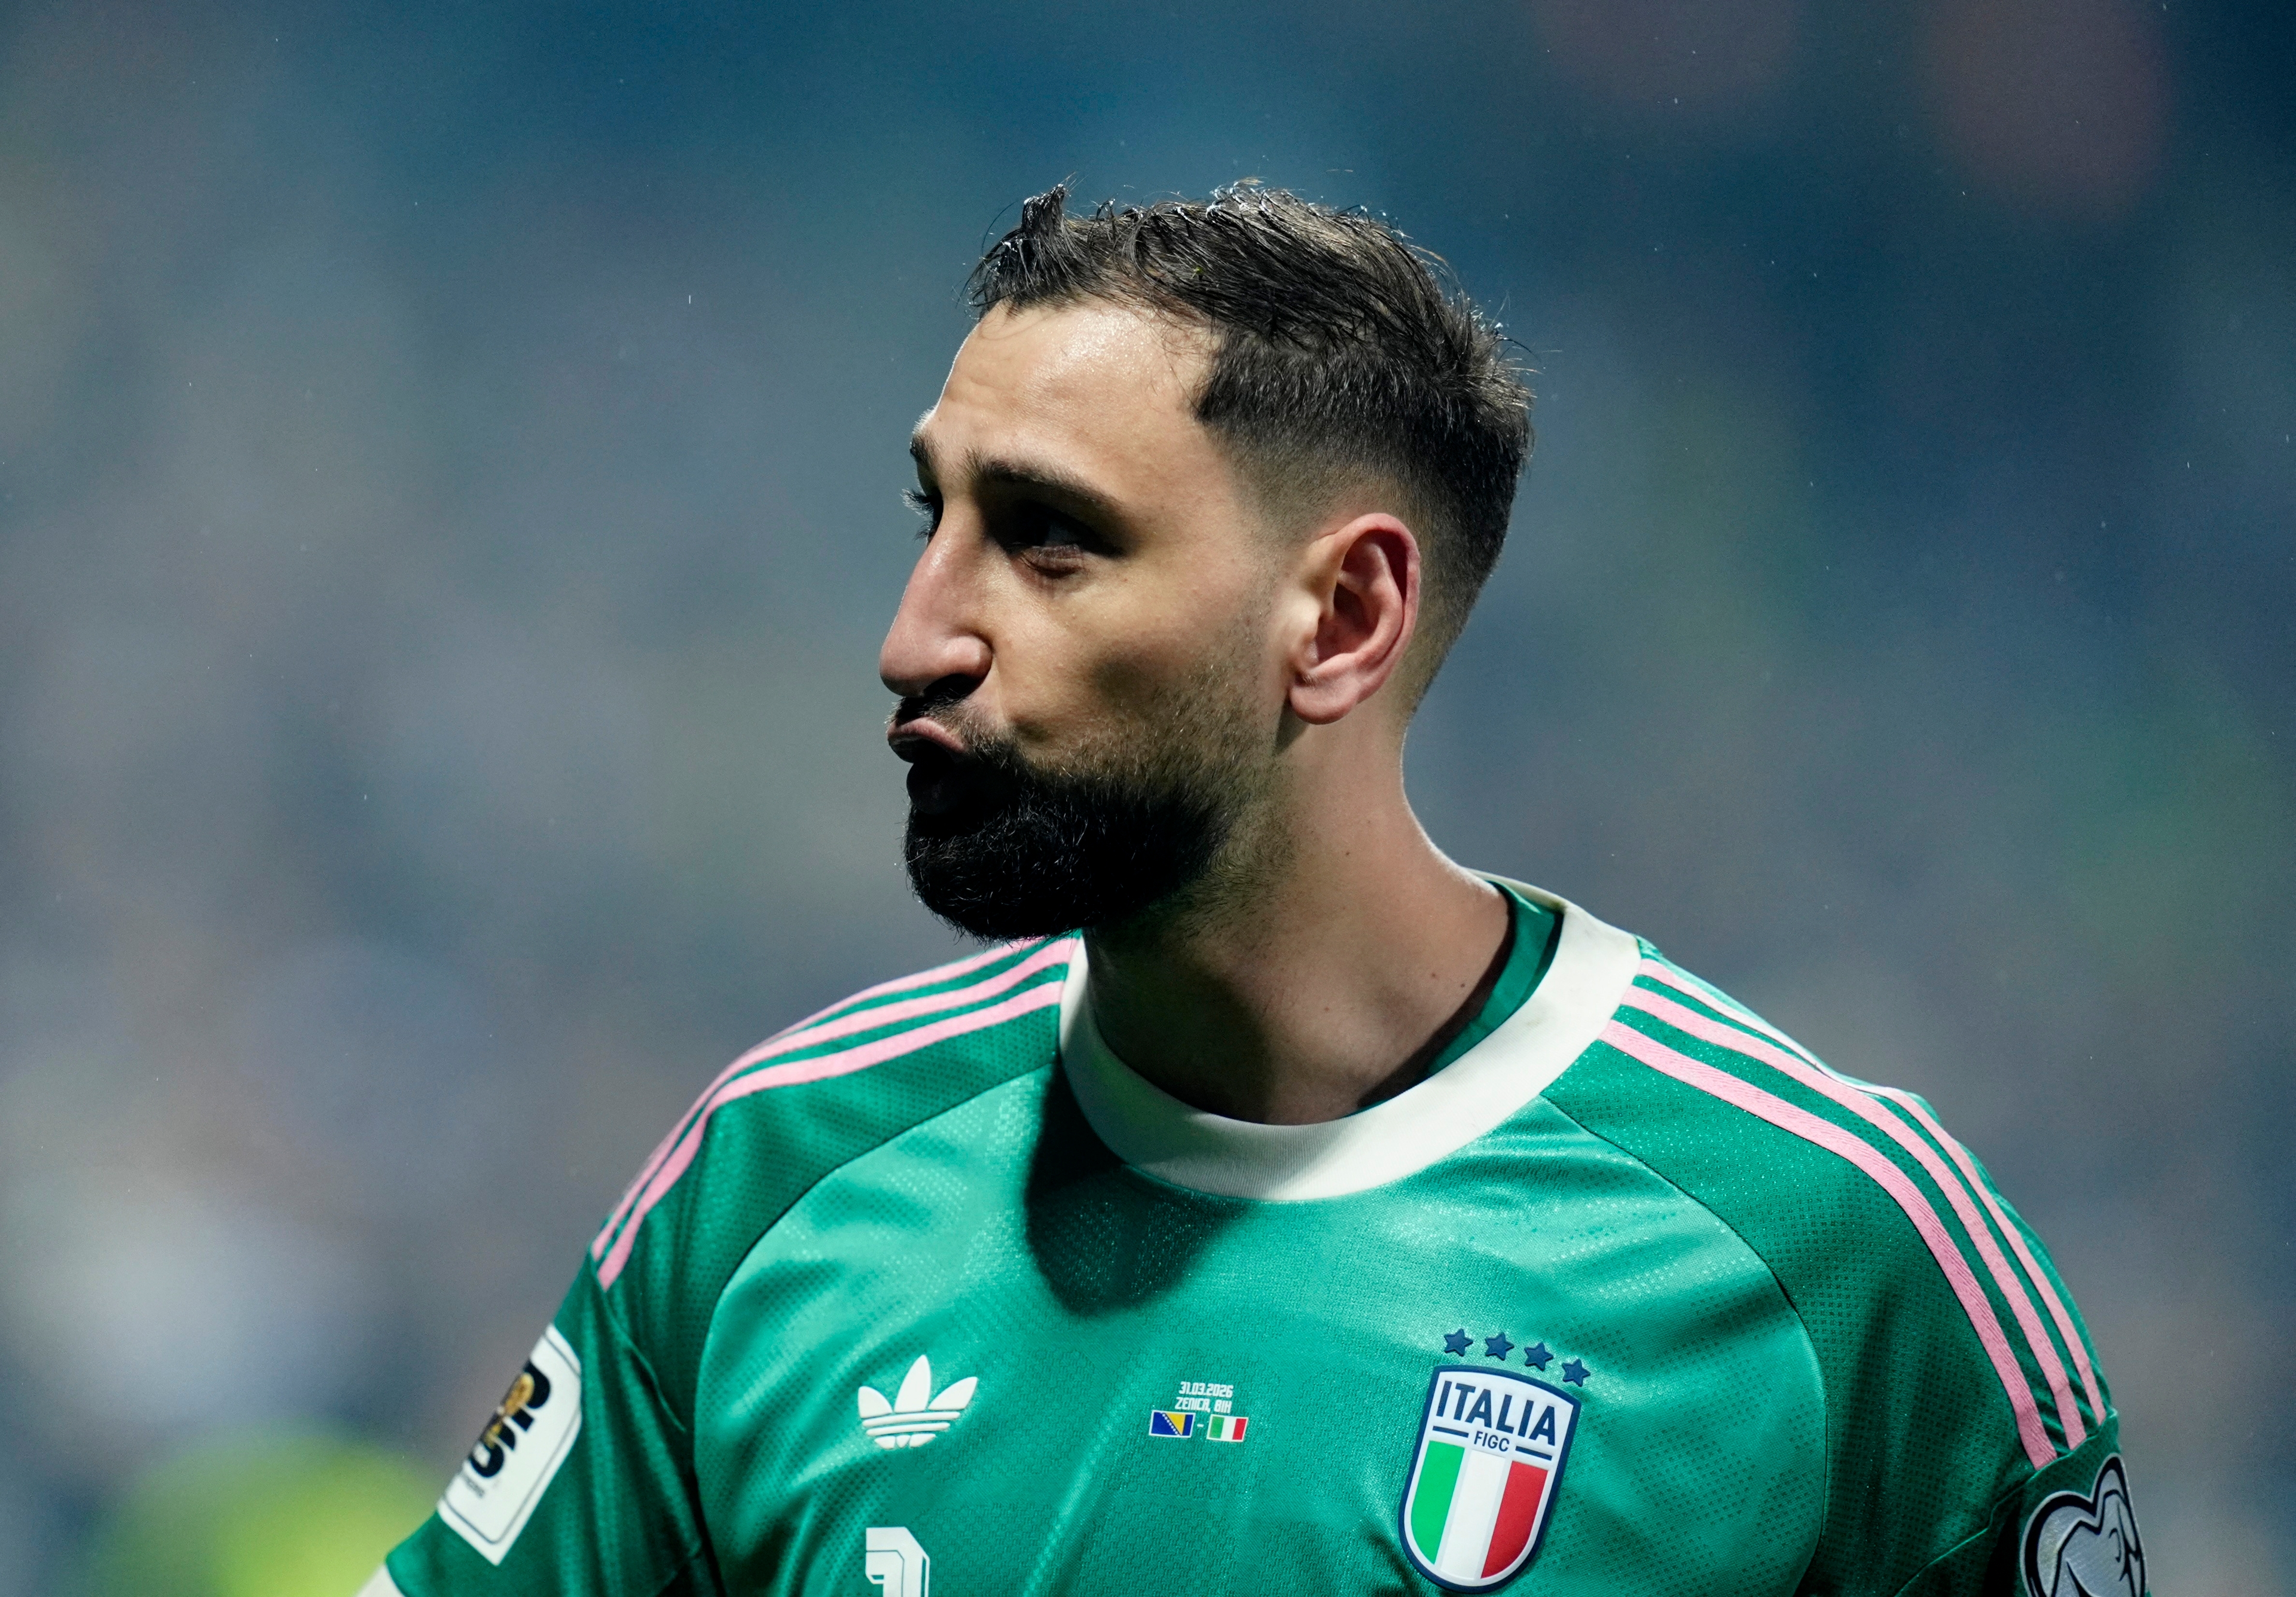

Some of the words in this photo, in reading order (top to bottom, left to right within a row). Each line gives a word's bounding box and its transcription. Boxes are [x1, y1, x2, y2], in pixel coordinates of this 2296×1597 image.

[1178, 1381, 1234, 1398] 31.03.2026
[1174, 1397, 1211, 1413] ZENICA,
[1214, 1399, 1232, 1413] BIH
[1436, 1380, 1556, 1446] ITALIA
[1474, 1431, 1510, 1452] FIGC
